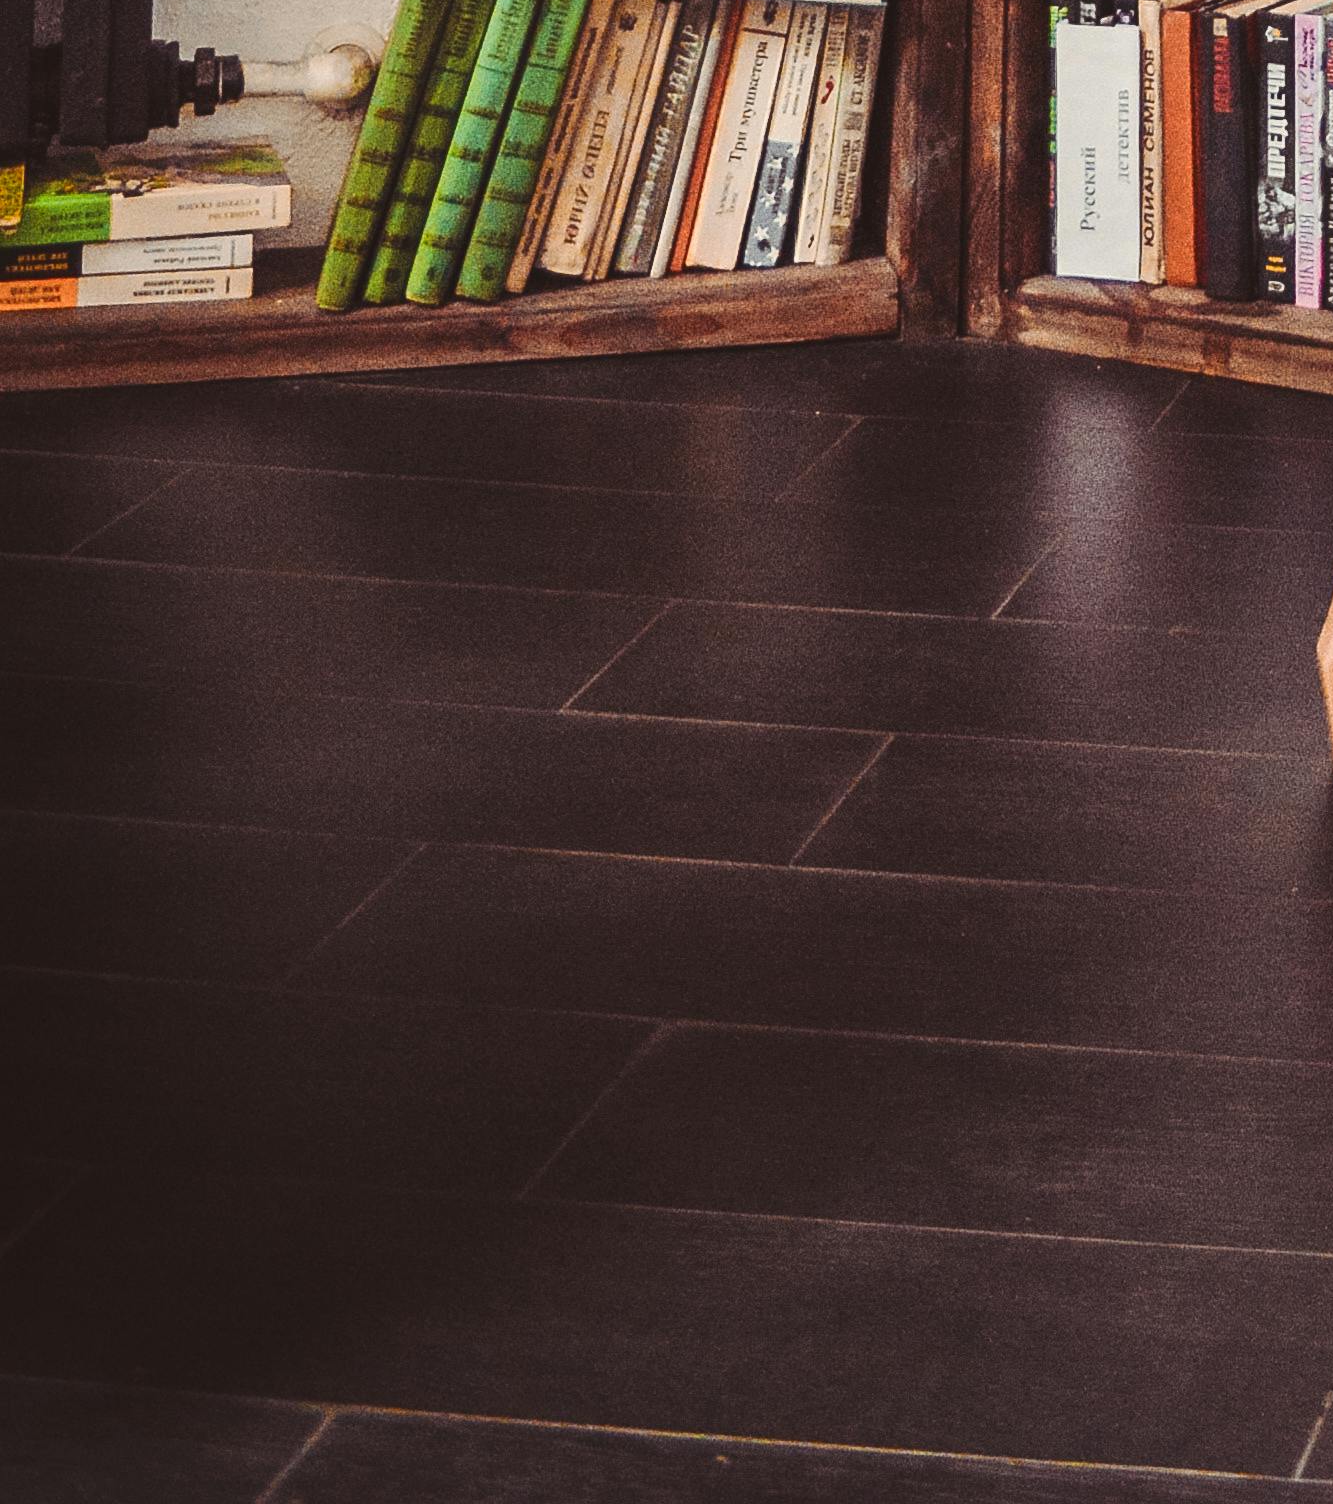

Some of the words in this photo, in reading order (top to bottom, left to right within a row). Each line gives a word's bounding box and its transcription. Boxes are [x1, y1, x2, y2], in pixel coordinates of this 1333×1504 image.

[662, 23, 701, 117] ГАЙДАР
[727, 130, 749, 163] Три
[738, 40, 769, 126] мушкетера
[1141, 48, 1156, 153] СЕМЕНОВ
[1116, 88, 1131, 184] детектив
[1266, 62, 1289, 179] ПРЕДТЕЧИ
[1299, 112, 1316, 205] ТОКАРЕВА
[563, 183, 589, 246] ЮРИЙ
[581, 109, 610, 180] ОЛЕША
[1079, 146, 1101, 232] Русский
[1142, 166, 1155, 248] ЮЛИАН
[1297, 213, 1316, 297] ВИКТОРИЯ
